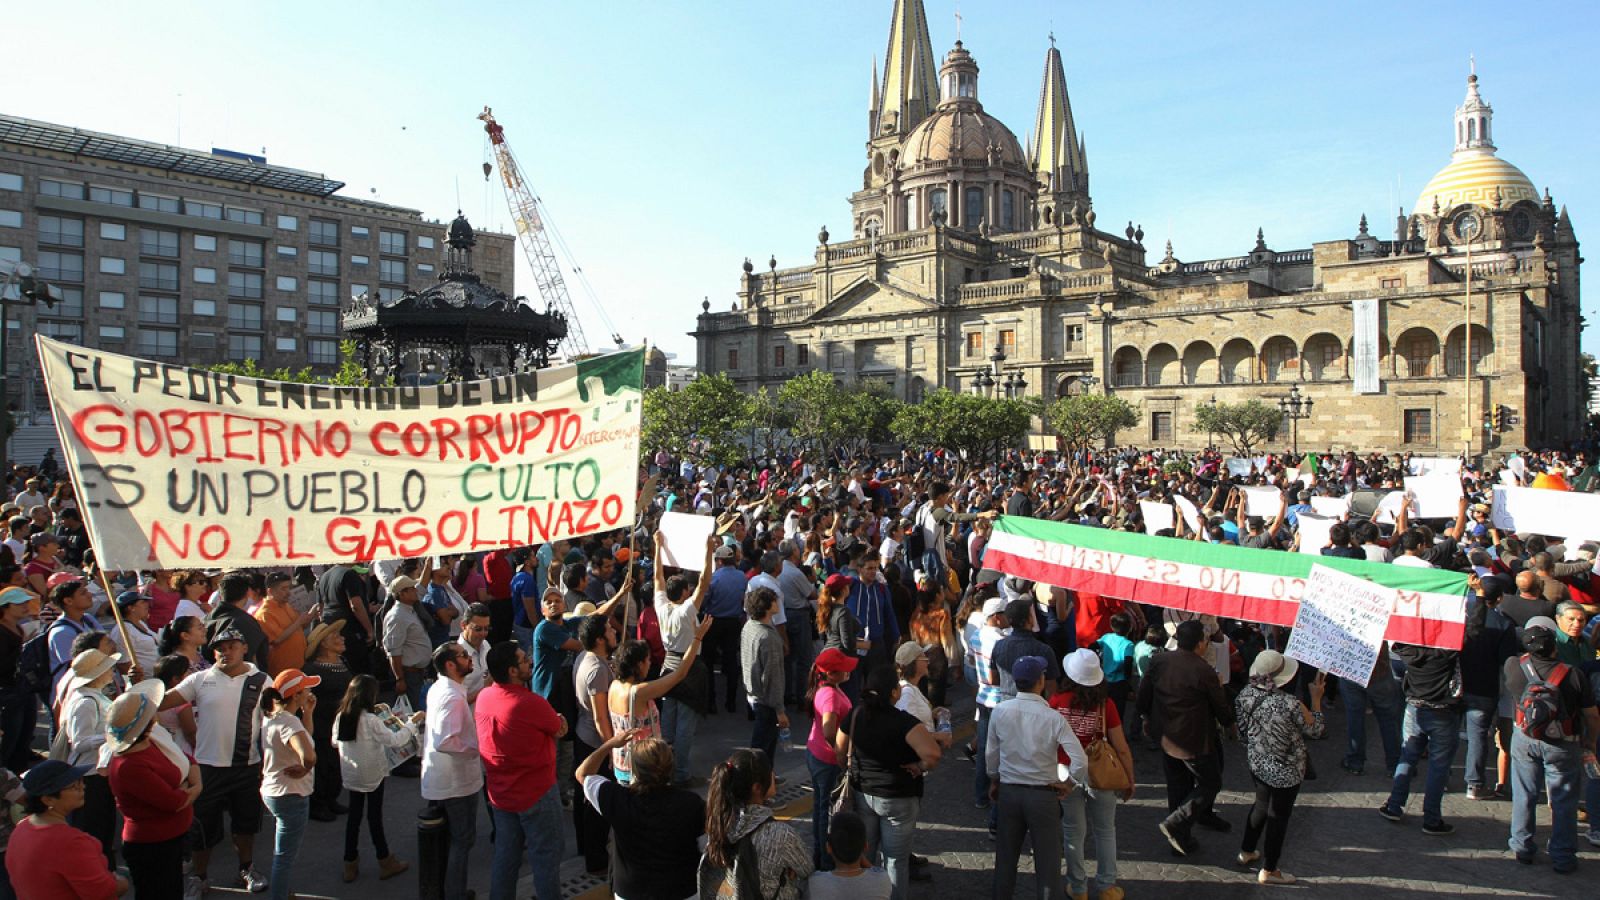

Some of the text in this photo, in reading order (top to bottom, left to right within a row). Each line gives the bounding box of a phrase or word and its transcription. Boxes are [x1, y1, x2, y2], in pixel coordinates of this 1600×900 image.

[67, 351, 116, 393] EL
[133, 360, 242, 405] PEOR
[437, 377, 482, 409] DE
[491, 371, 538, 404] UN
[72, 404, 581, 467] GOBIERNO CORRUPTO
[80, 457, 601, 516] ES UN PUEBLO CULTO
[147, 494, 623, 562] NO AL GASOLINAZO
